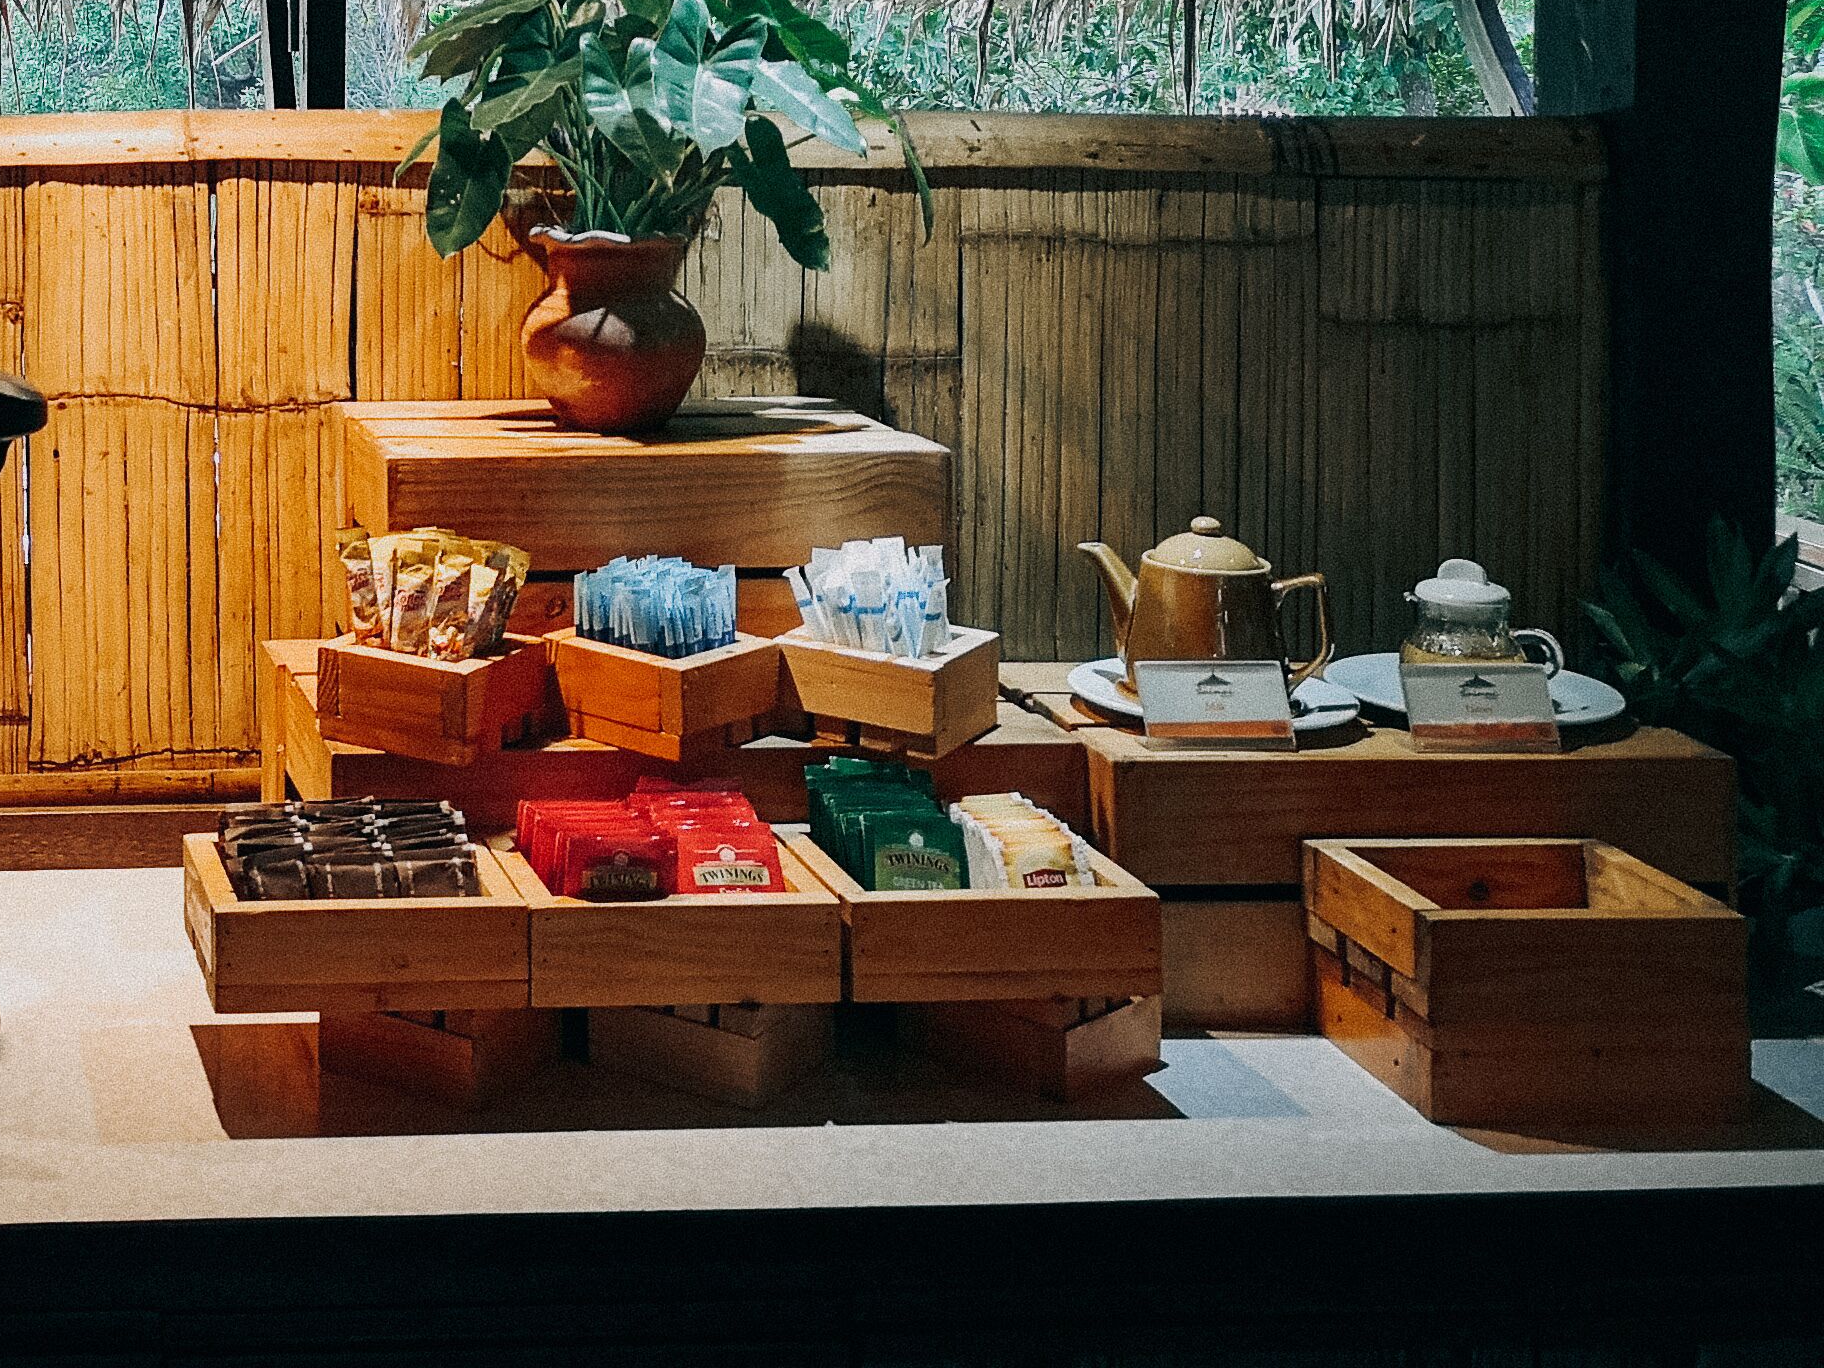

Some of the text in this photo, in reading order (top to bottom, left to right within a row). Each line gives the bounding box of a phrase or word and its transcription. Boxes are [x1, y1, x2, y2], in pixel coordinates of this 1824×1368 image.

[884, 853, 951, 874] TWININGS
[700, 868, 764, 884] TWININGS
[1026, 873, 1065, 886] Lipton
